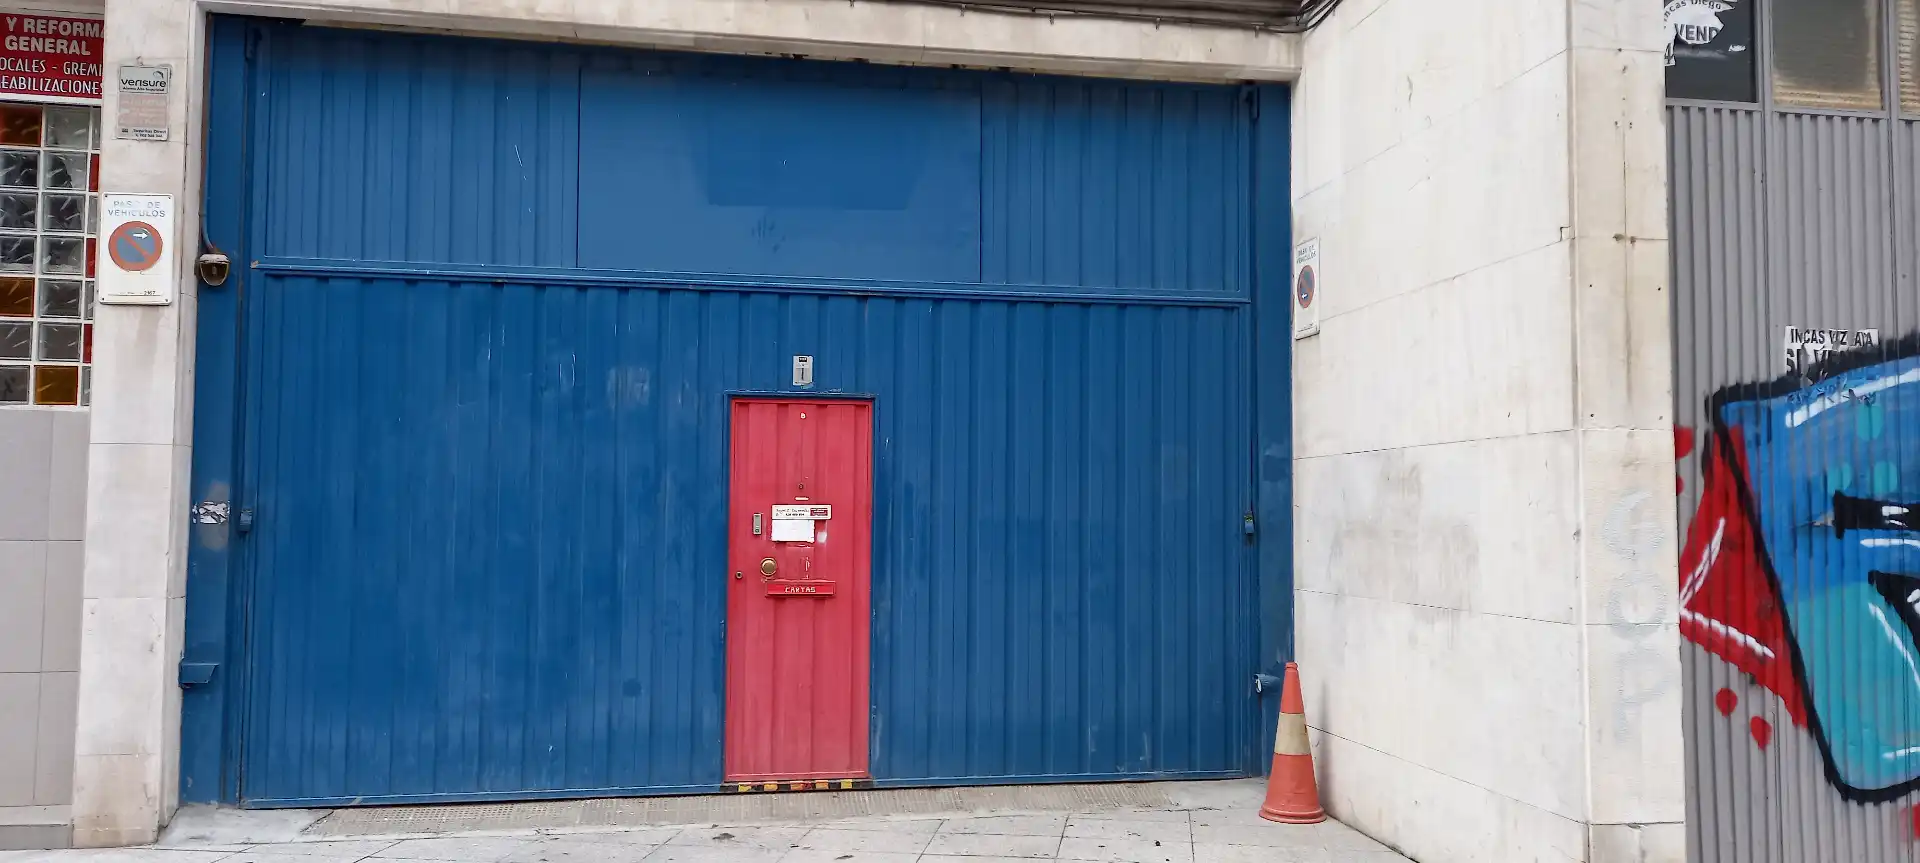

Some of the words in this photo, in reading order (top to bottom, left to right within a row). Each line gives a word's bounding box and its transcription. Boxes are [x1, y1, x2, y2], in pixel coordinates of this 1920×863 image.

[6, 16, 17, 32] Y
[5, 35, 91, 55] GENERAL
[147, 201, 161, 209] DE
[108, 209, 166, 218] VEHICULOS
[784, 586, 816, 594] CARTAS
